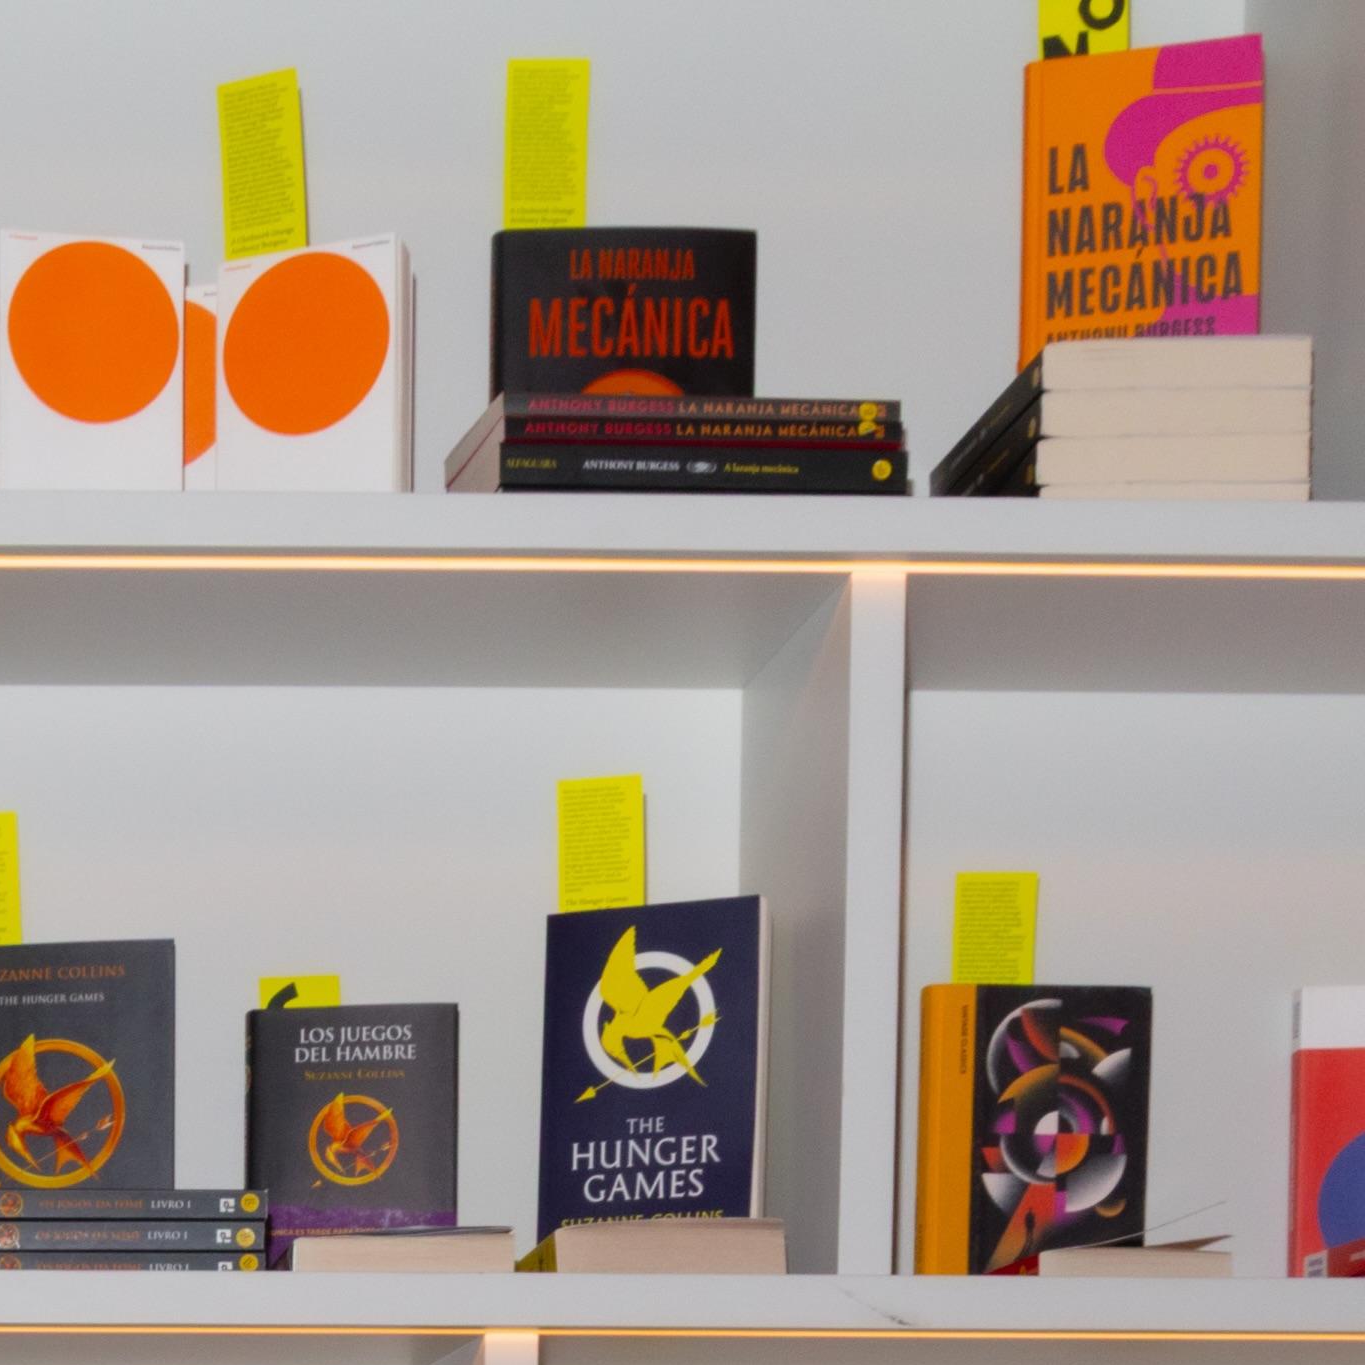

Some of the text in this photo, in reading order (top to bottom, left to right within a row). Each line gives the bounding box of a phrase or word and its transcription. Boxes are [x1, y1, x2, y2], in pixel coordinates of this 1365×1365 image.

[1048, 143, 1090, 196] LA
[1046, 191, 1232, 259] NARANJA
[570, 248, 695, 281] LA NARANJA
[1045, 245, 1243, 320] MECÁNICA
[527, 283, 735, 360] MECÁNICA
[583, 458, 680, 473] ANTHONY BURGESS
[57, 964, 126, 981] COLLINS
[0, 991, 105, 1006] THE HUNGER GAMES
[299, 1025, 412, 1045] LOS JUEGOS
[294, 1043, 417, 1064] DEL HAMBRE
[626, 1116, 665, 1136] THE
[571, 1134, 721, 1172] HUNGER
[583, 1167, 706, 1203] GAMES
